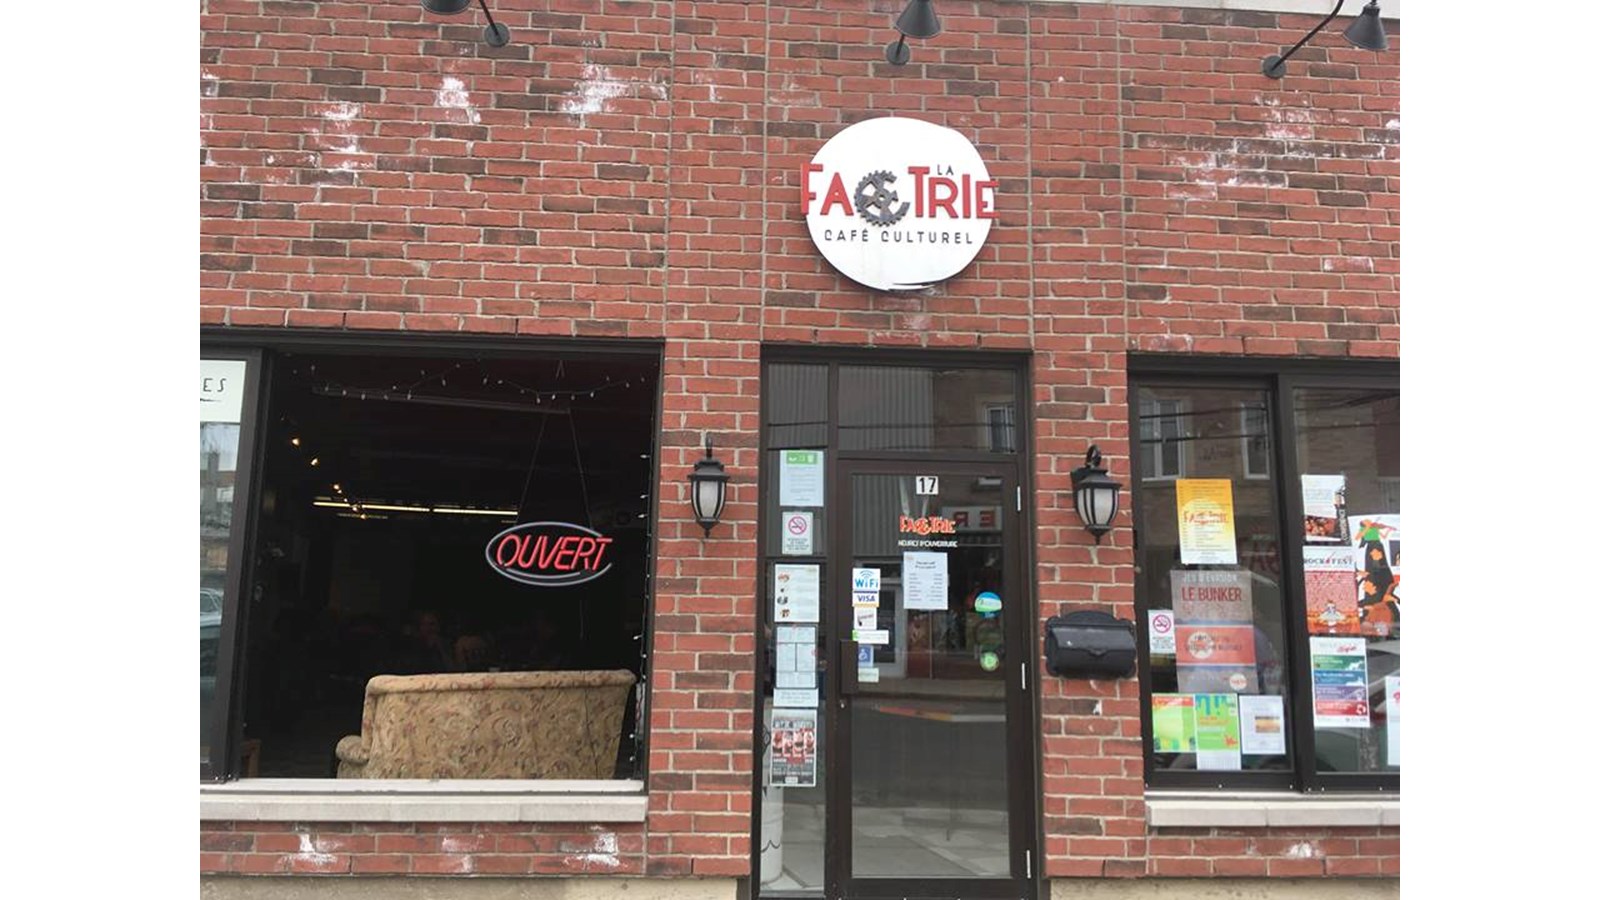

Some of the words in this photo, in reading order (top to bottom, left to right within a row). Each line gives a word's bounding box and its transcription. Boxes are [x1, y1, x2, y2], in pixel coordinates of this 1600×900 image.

[937, 164, 954, 176] LA
[824, 228, 869, 242] CAFÉ
[881, 231, 973, 245] CULTUREL
[919, 477, 936, 493] 17
[497, 534, 613, 571] OUVERT
[855, 579, 878, 588] WiFi
[1181, 587, 1195, 601] LE
[1198, 587, 1242, 602] BUNKER
